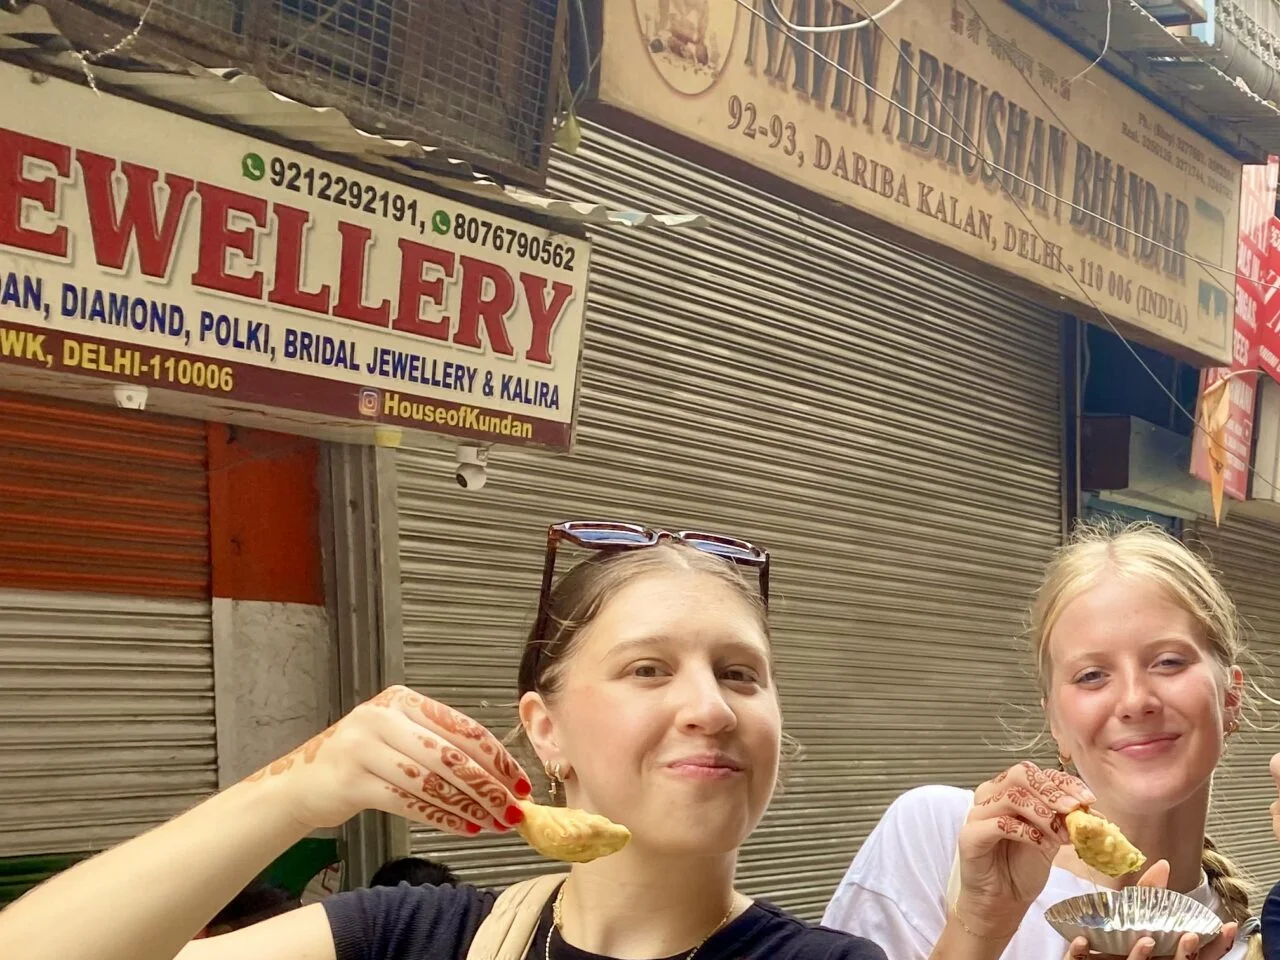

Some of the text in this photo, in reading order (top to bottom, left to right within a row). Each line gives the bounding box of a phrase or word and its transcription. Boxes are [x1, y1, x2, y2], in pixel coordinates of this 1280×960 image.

[270, 157, 576, 271] 9212292191, 8076790562
[727, 94, 805, 167] 92-93,
[812, 134, 910, 208] DARIBA
[916, 181, 997, 251] KALAN,
[1003, 222, 1064, 273] DELHI
[1079, 257, 1103, 291] 110
[1108, 270, 1133, 304] 006
[1136, 285, 1189, 334] (INDIA)
[883, 38, 1068, 218] ABHUSHAN
[1069, 139, 1190, 284] BHANDAR
[0, 272, 560, 410] AN, DIAMOND, POLKI, BRIDAL JEWELLERY & KALIRA
[63, 339, 234, 391] DELHI-110006
[384, 392, 532, 438] HouseofKundan
